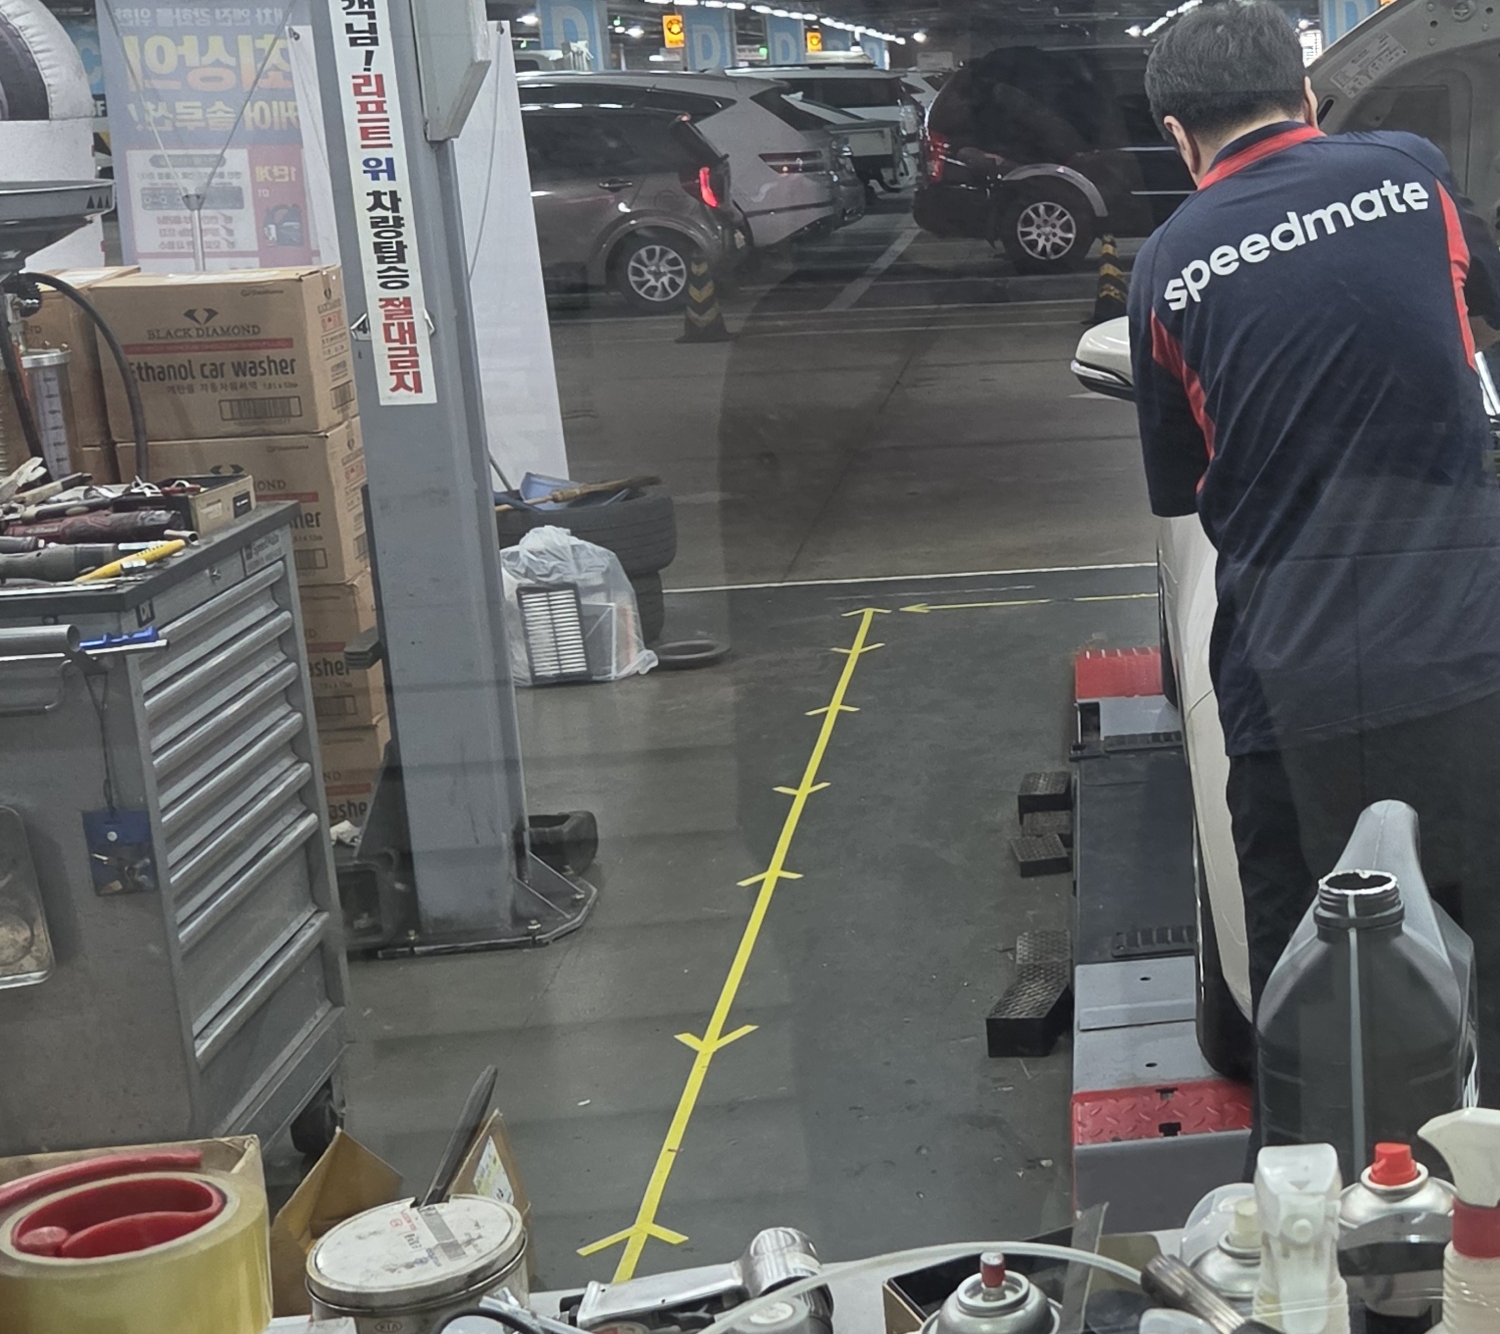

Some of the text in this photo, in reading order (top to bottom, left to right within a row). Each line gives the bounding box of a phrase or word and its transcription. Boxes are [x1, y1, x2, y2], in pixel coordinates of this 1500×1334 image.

[352, 73, 393, 149] 리프트
[362, 157, 396, 181] 위
[366, 190, 409, 290] 차량탑승
[1164, 179, 1429, 311] speedmate
[147, 324, 261, 340] BLACK DIAMOND
[201, 362, 226, 380] car
[231, 355, 297, 378] washer
[378, 296, 423, 394] 절대금지
